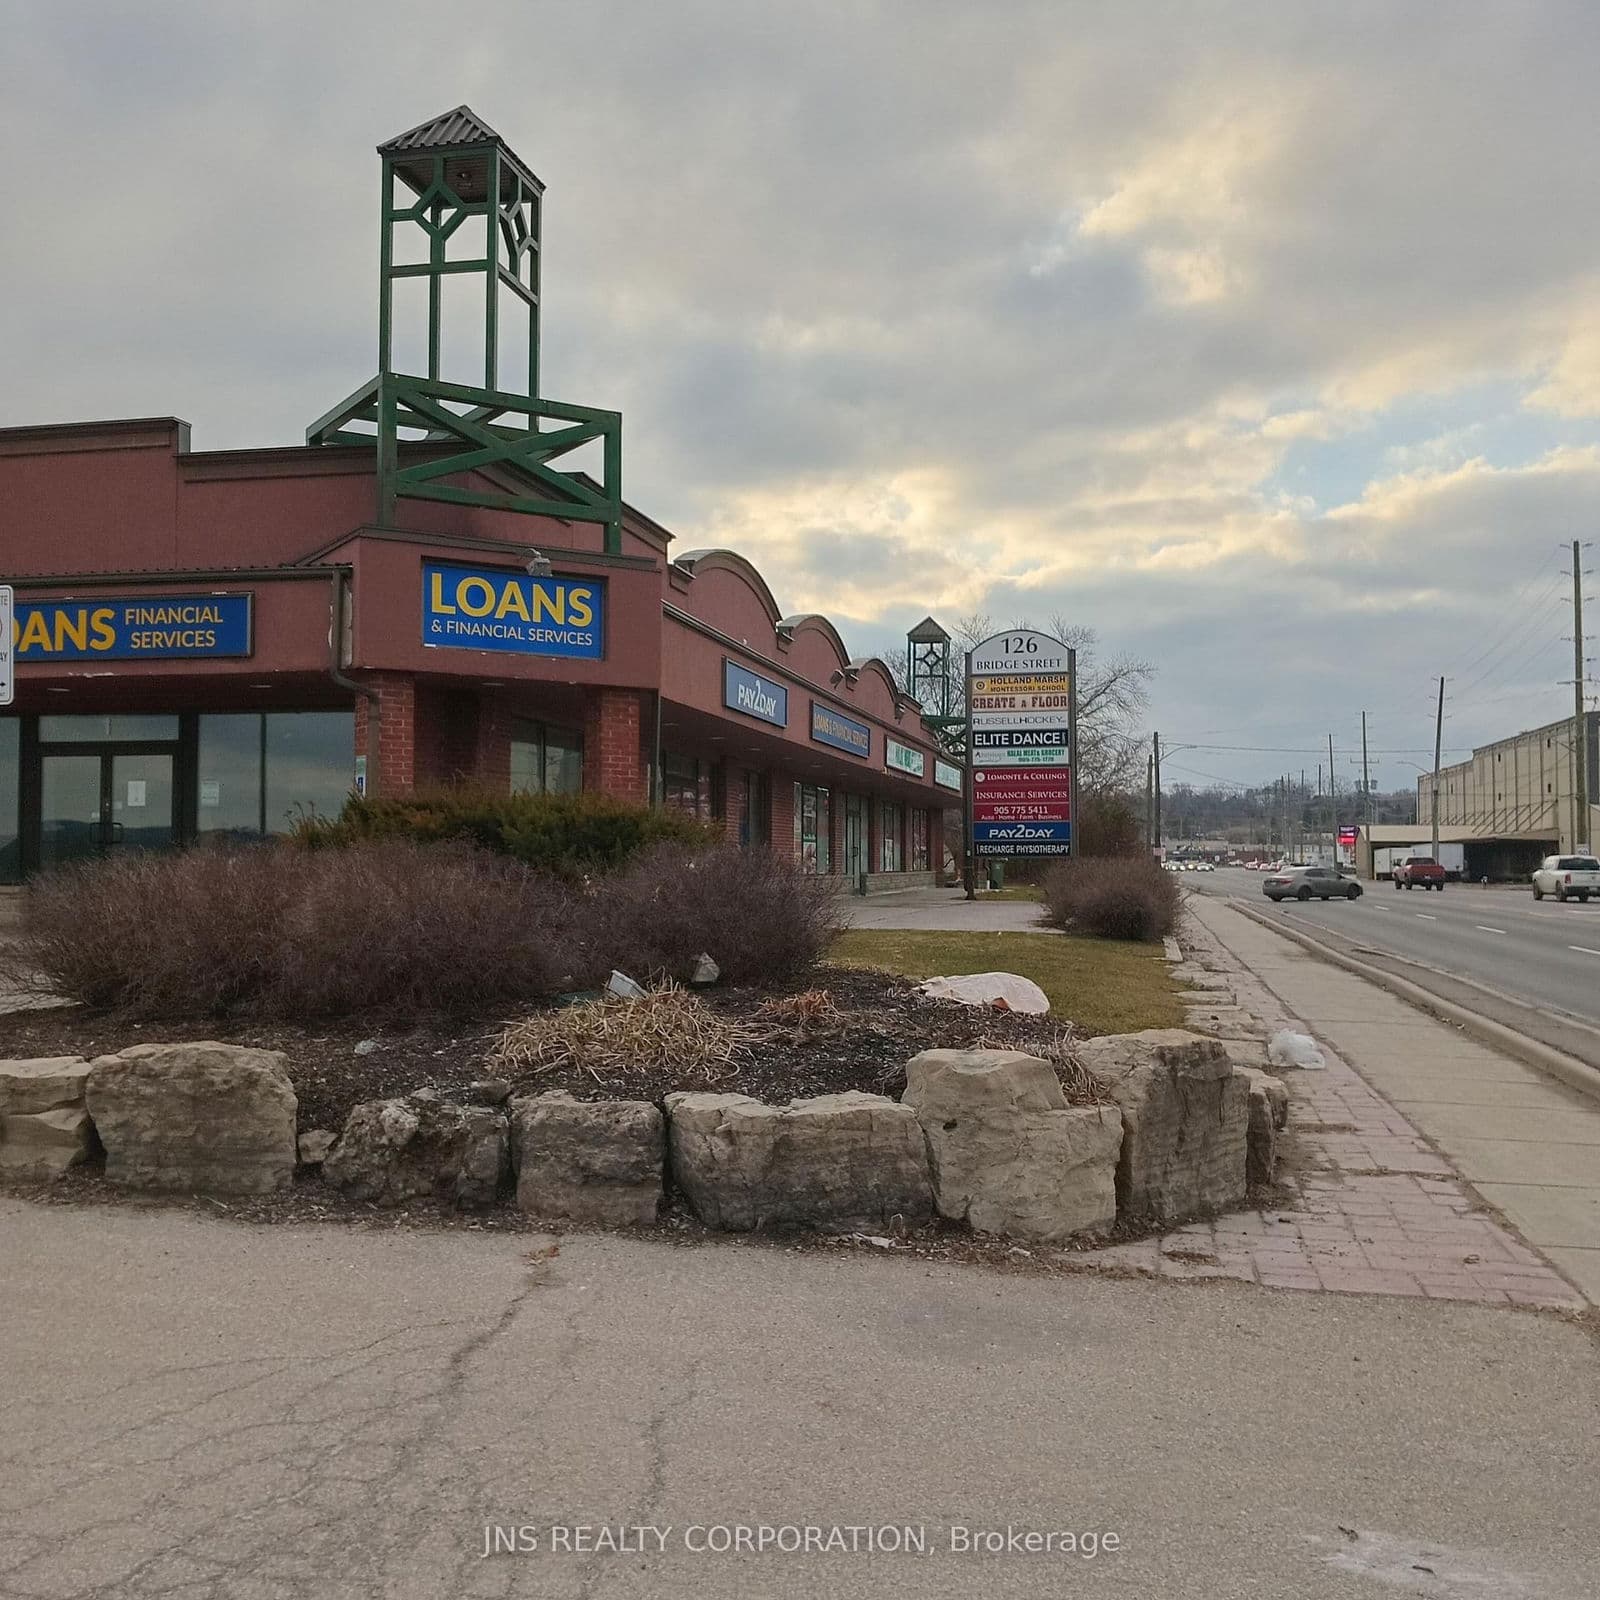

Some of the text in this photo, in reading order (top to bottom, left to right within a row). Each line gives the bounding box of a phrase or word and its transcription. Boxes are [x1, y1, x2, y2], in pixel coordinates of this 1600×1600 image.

[431, 573, 593, 627] LOANS
[125, 606, 223, 625] FINANCIAL
[130, 630, 216, 649] SERVICES
[431, 619, 593, 646] & FINANCIAL SERVICES
[1001, 636, 1038, 654] 126
[976, 658, 1061, 670] BRIDGE STREET
[1035, 676, 1066, 684] MARSH
[738, 680, 777, 717] PAY2DAY
[973, 697, 1016, 709] CREATE
[1032, 696, 1067, 708] FLOOR
[975, 733, 1010, 746] ELITE
[1013, 732, 1060, 745] DANCE
[1030, 772, 1066, 780] COLLINGS
[976, 790, 1067, 799] INSURANCE SERVICES
[993, 805, 1048, 815] 905 775 5411
[989, 824, 1054, 838] PAY2DAY
[979, 844, 1069, 854] RECHARGE PHYSIOTHERAPY
